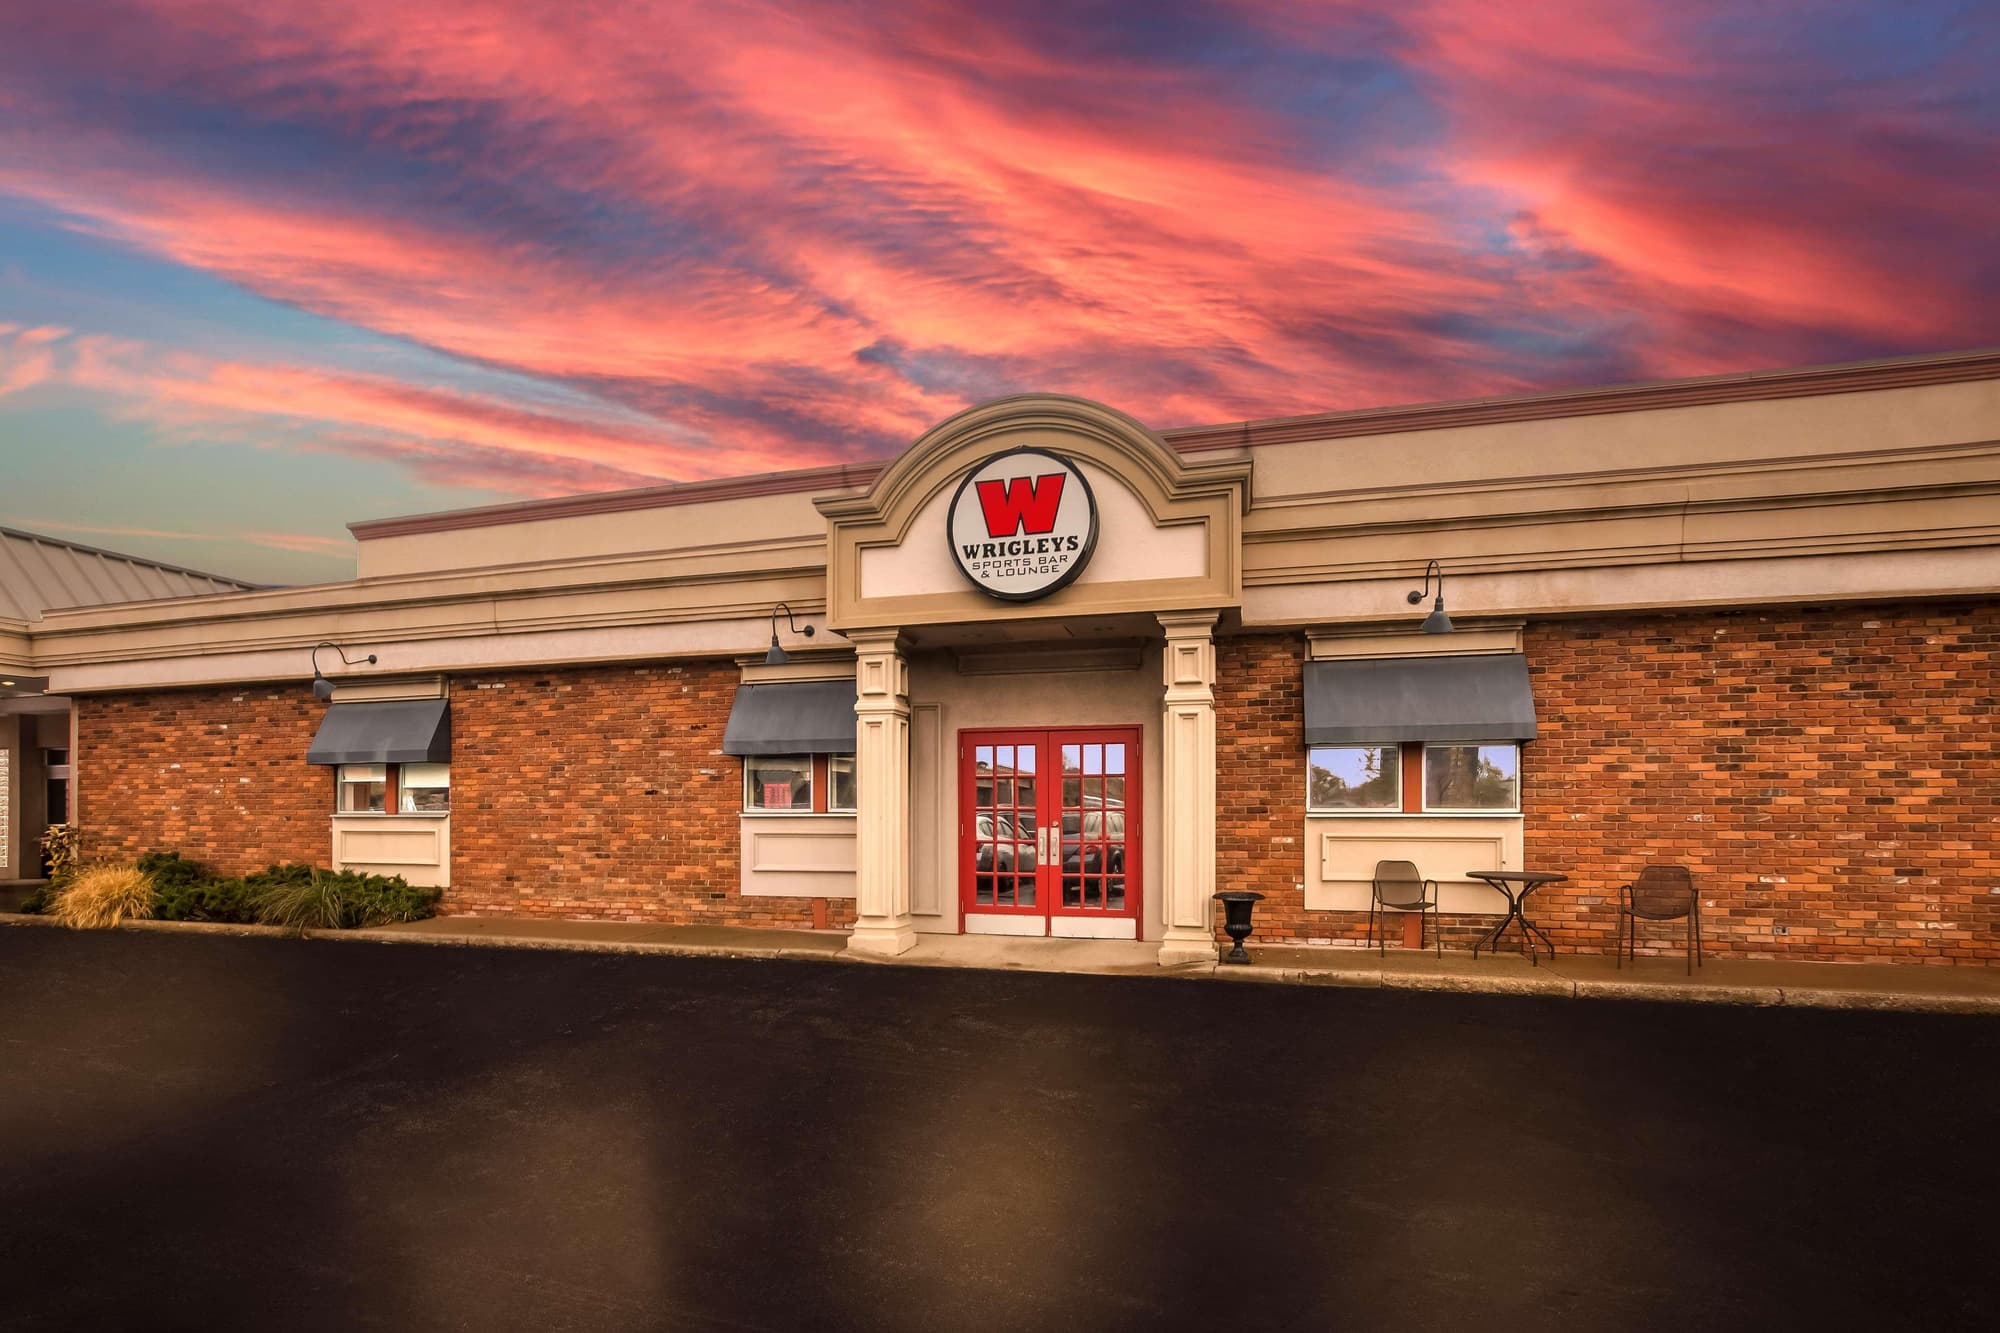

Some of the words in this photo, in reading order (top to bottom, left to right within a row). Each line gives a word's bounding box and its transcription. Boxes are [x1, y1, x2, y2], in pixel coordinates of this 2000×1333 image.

[975, 472, 1067, 538] W
[962, 535, 1079, 560] WRIGLEYS
[972, 558, 1031, 570] SPORTS
[1038, 555, 1068, 565] BAR
[980, 570, 991, 578] &
[997, 564, 1060, 577] LOUNGE
